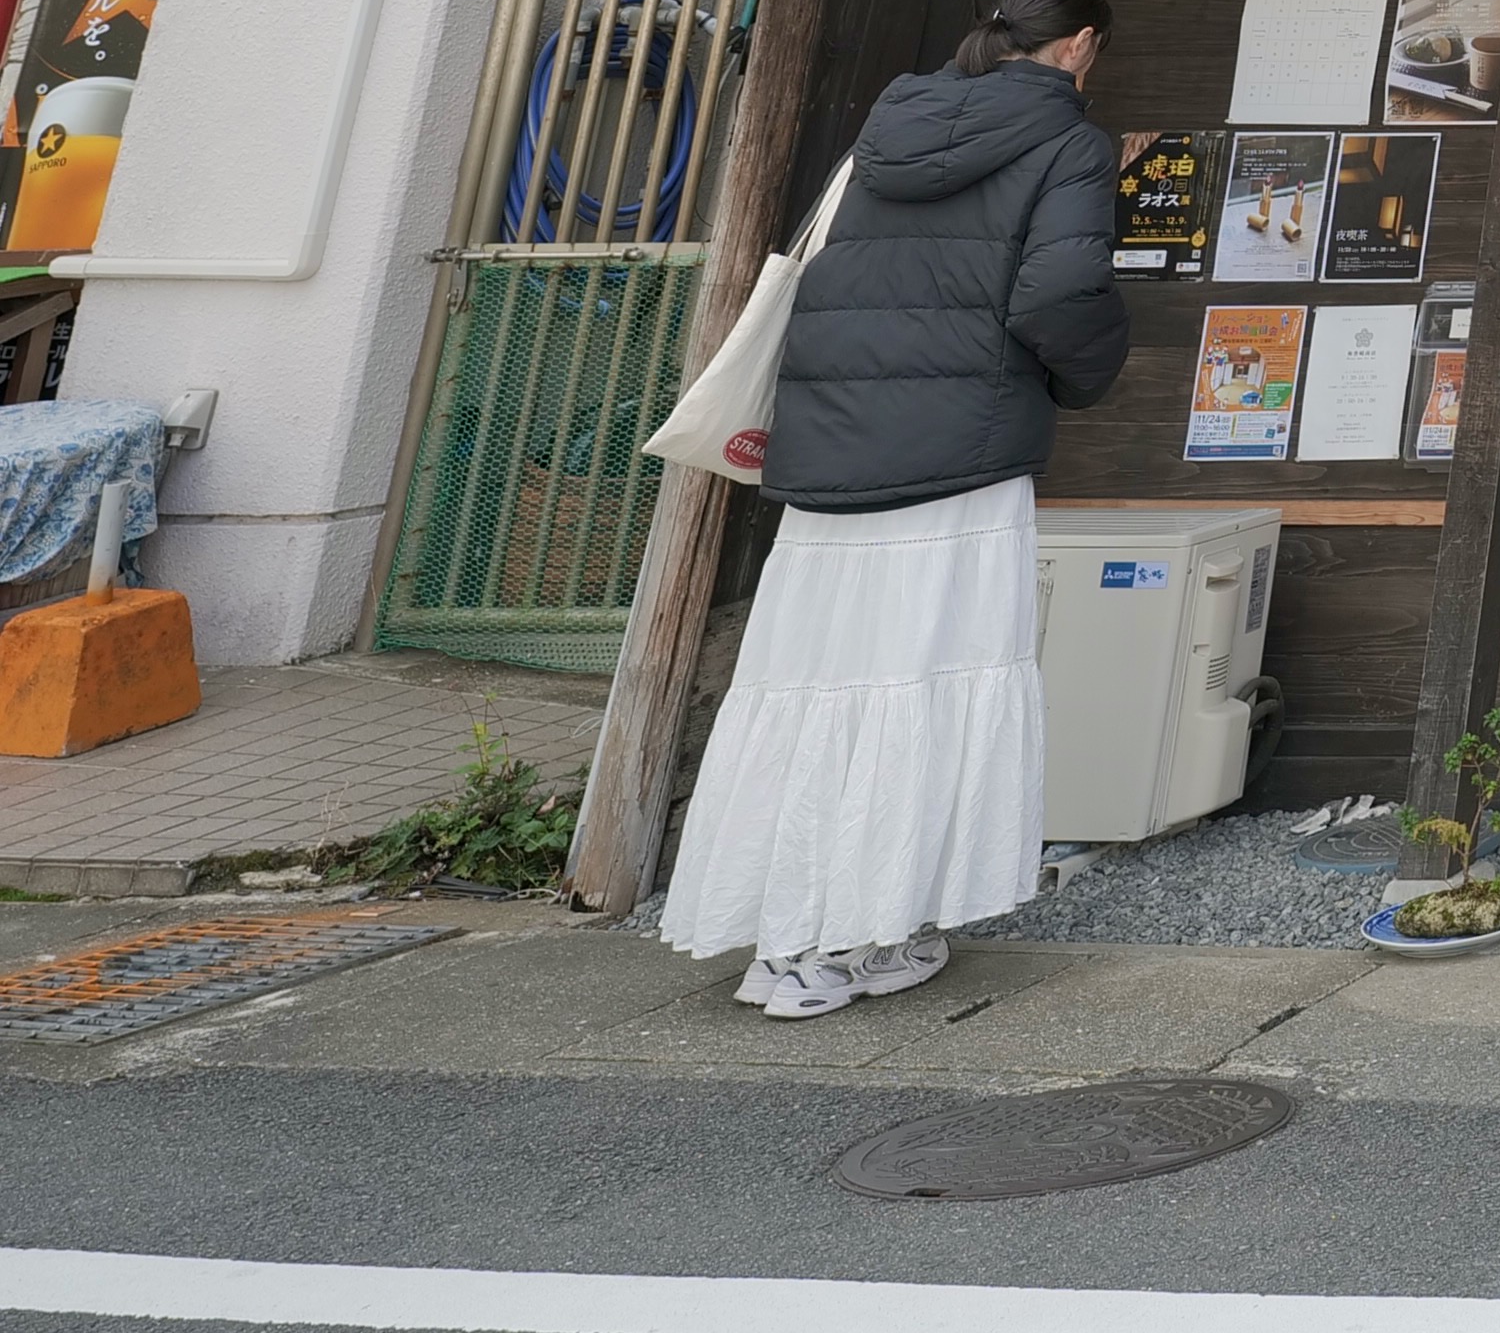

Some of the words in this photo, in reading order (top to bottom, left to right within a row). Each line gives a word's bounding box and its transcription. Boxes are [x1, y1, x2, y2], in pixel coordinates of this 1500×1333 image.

[29, 156, 67, 174] SAPPORO
[1142, 153, 1195, 181] 琥珀
[1335, 229, 1368, 242] 夜喫茶
[729, 436, 766, 460] STRAN
